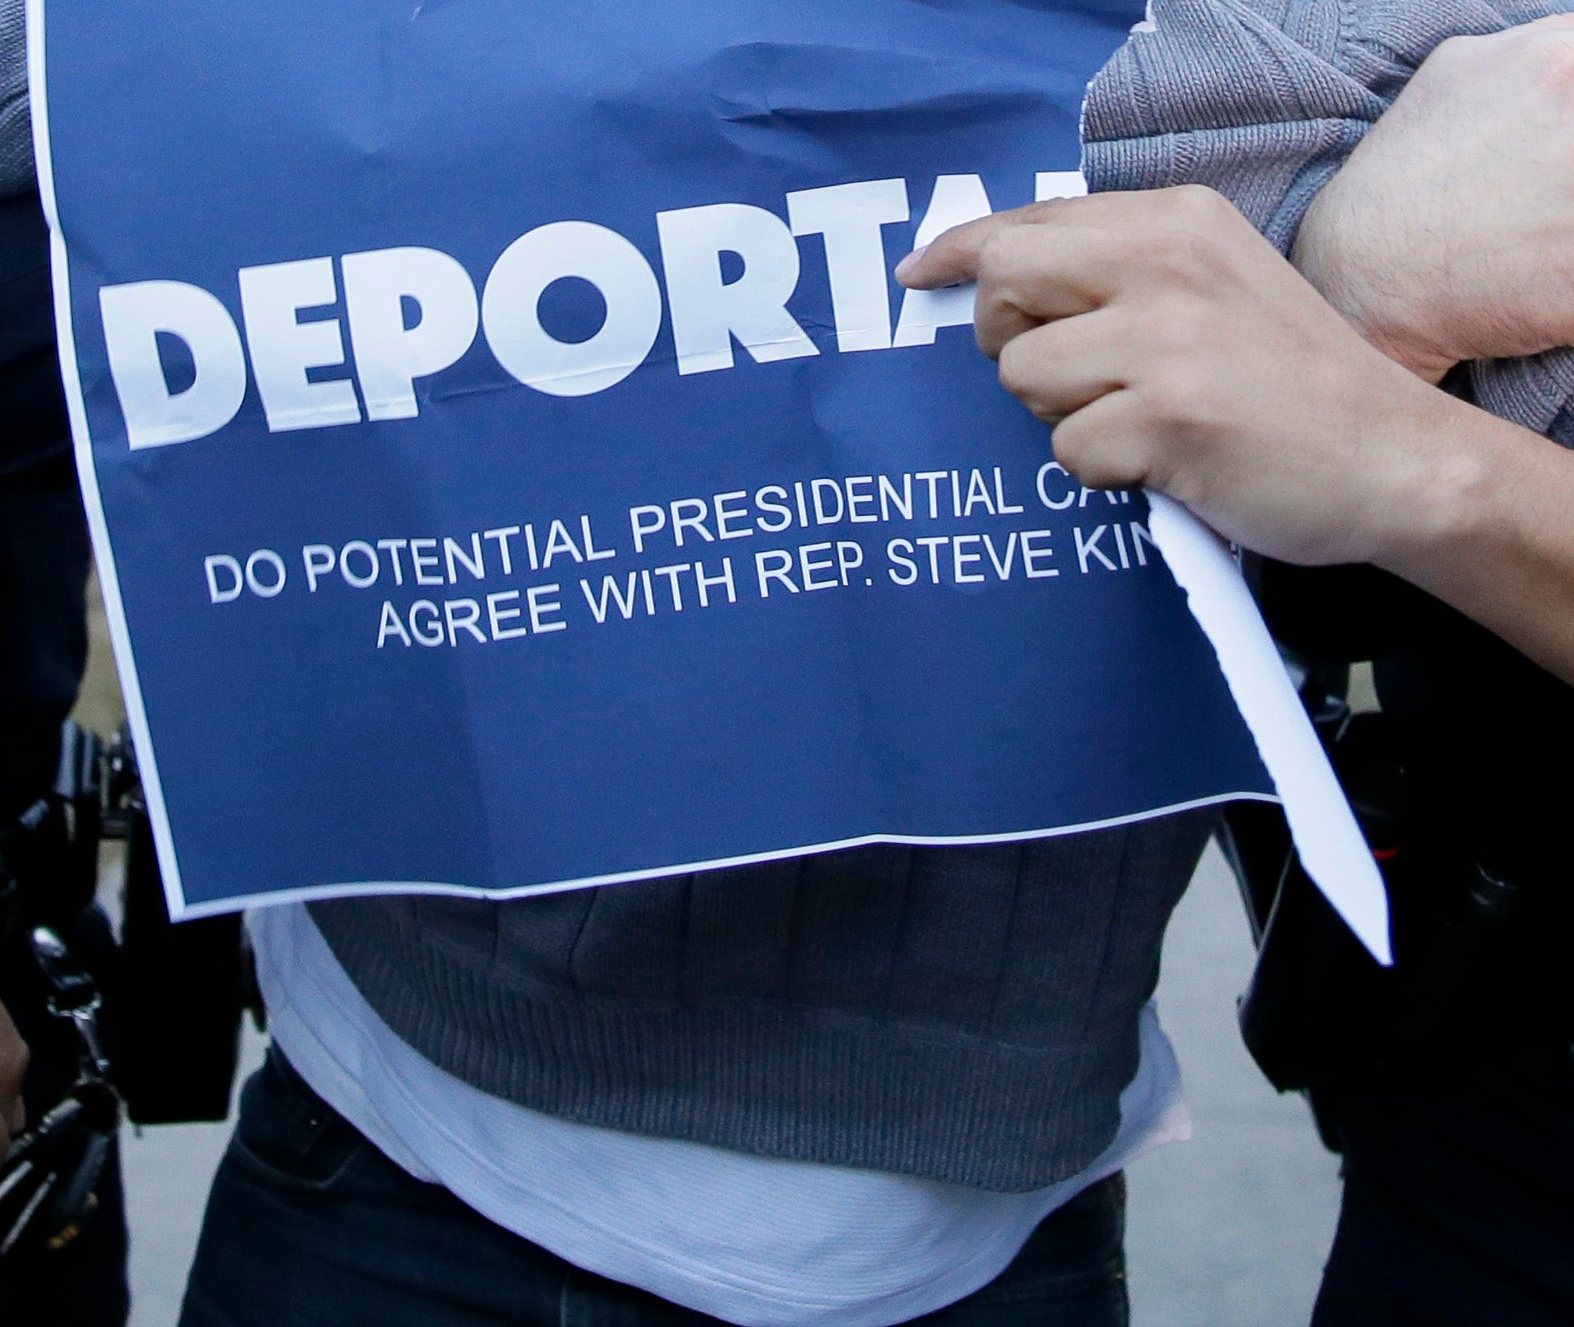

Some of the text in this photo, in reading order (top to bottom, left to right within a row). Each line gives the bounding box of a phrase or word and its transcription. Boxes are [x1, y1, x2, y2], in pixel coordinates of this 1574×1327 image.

[99, 170, 1088, 451] DEPORTA
[203, 548, 287, 604] DO
[301, 514, 616, 594] POTENTIAL
[628, 466, 1025, 553] PRESIDENTIAL
[376, 583, 568, 649] AGREE
[579, 557, 737, 624] WITH
[754, 539, 874, 598] REP.
[887, 529, 1060, 587] STEVE
